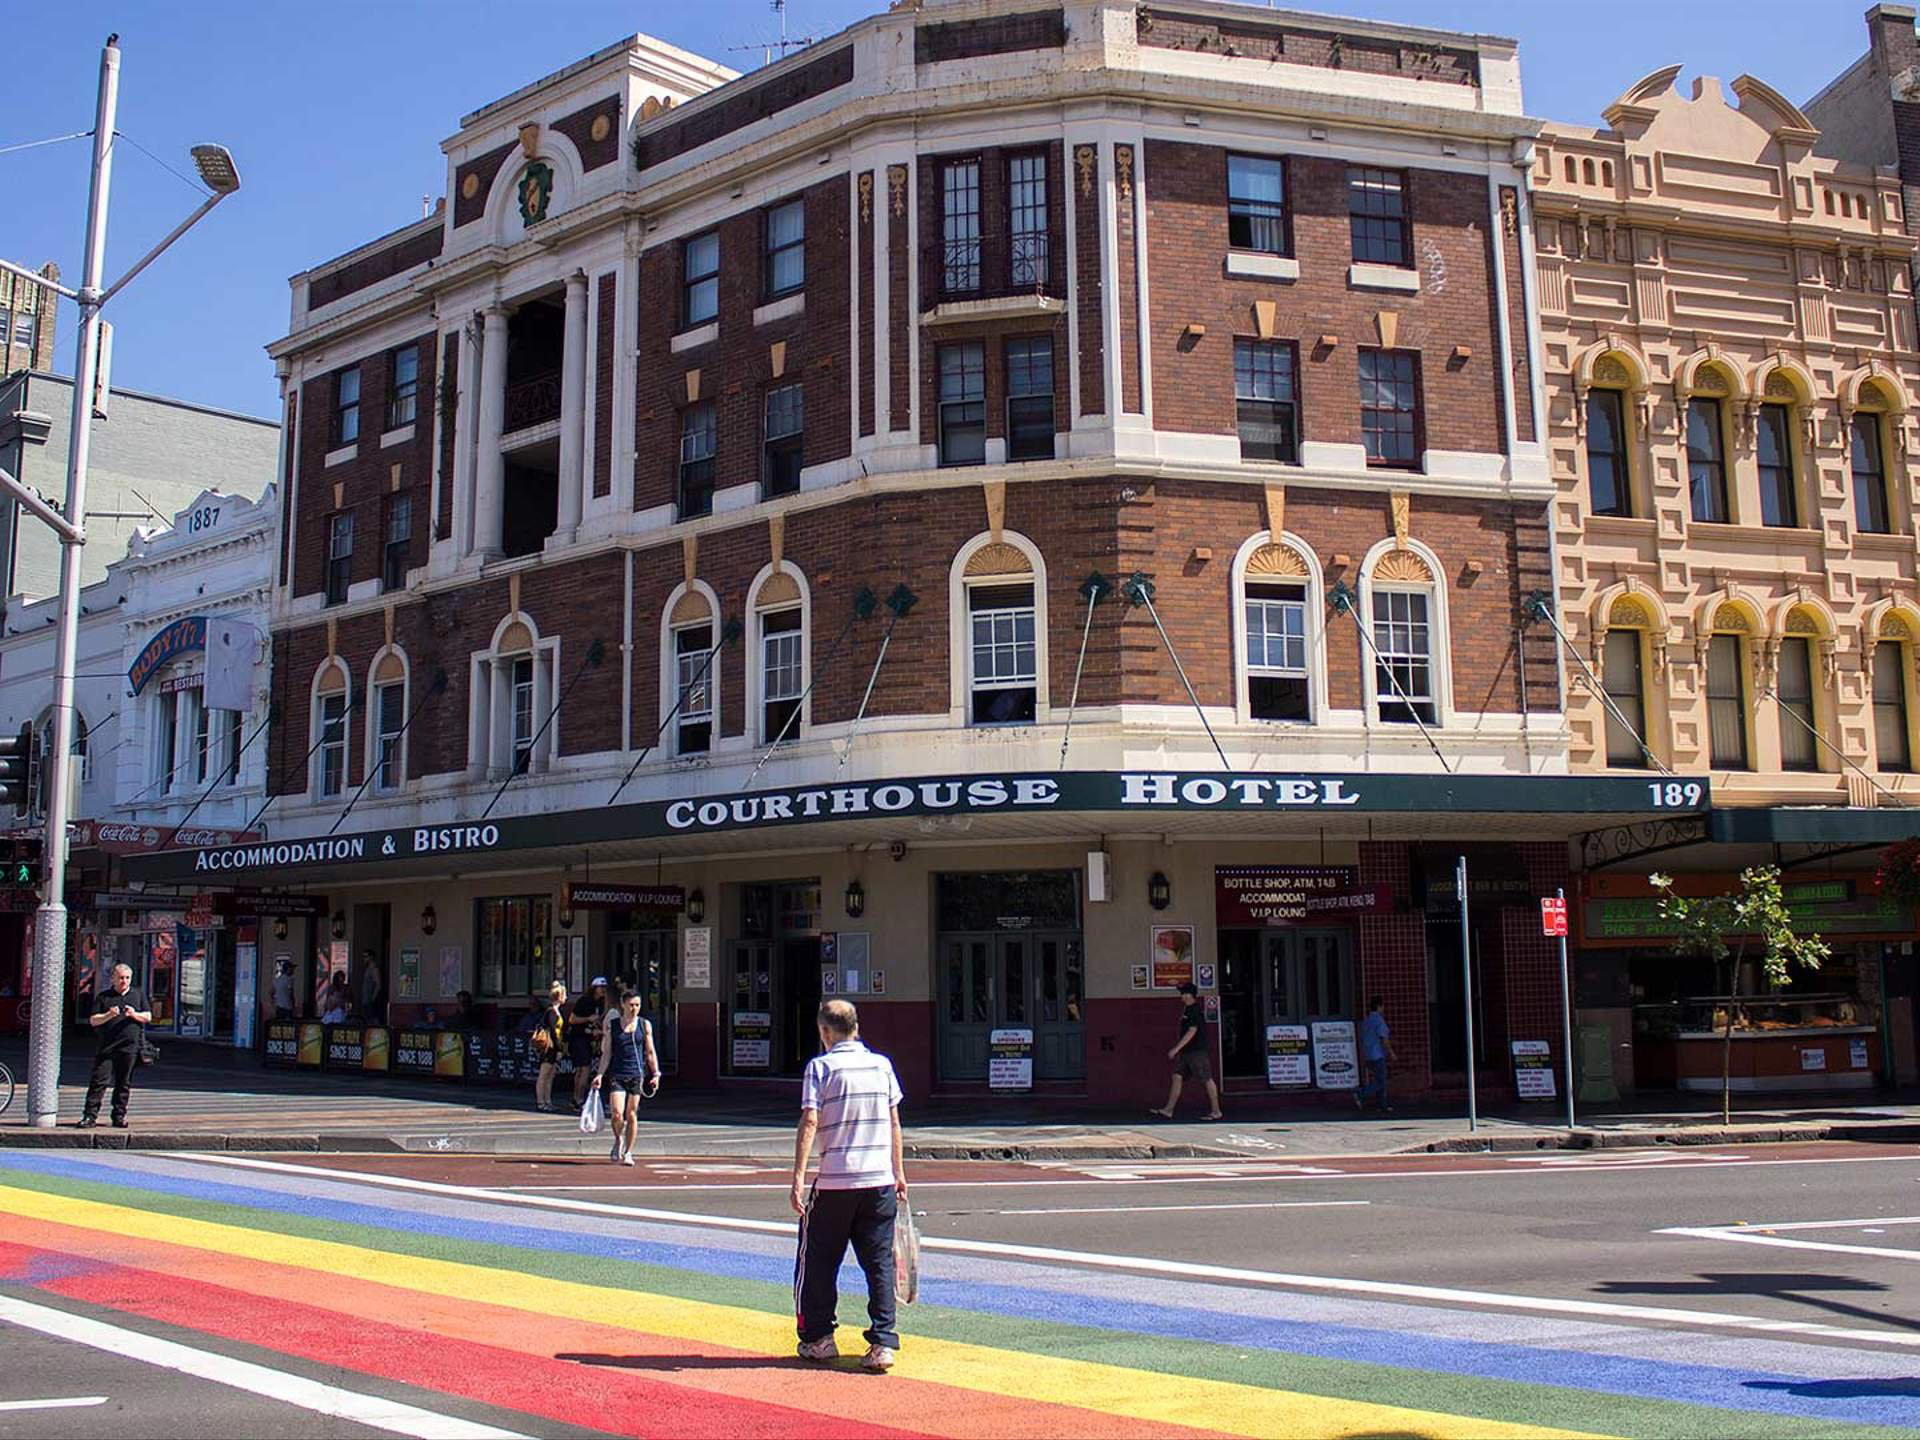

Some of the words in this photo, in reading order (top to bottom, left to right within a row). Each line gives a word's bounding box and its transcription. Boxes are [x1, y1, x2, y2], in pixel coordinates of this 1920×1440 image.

[188, 507, 221, 534] 1887
[132, 631, 172, 685] BODY
[665, 778, 1060, 829] COURTHOUSE
[1121, 775, 1360, 806] HOTEL
[1648, 782, 1703, 808] 189
[195, 838, 364, 871] ACCOMMODATION
[382, 835, 396, 855] &
[413, 825, 499, 852] BISTRO
[1224, 877, 1263, 890] BOTTLE
[573, 890, 636, 903] ACCOMMODATION
[1240, 892, 1306, 904] ACCOMMODAT
[1273, 907, 1306, 918] LOUNG
[267, 1040, 283, 1055] SINCE
[329, 1045, 347, 1059] SINCE
[397, 1050, 416, 1065] SINCE
